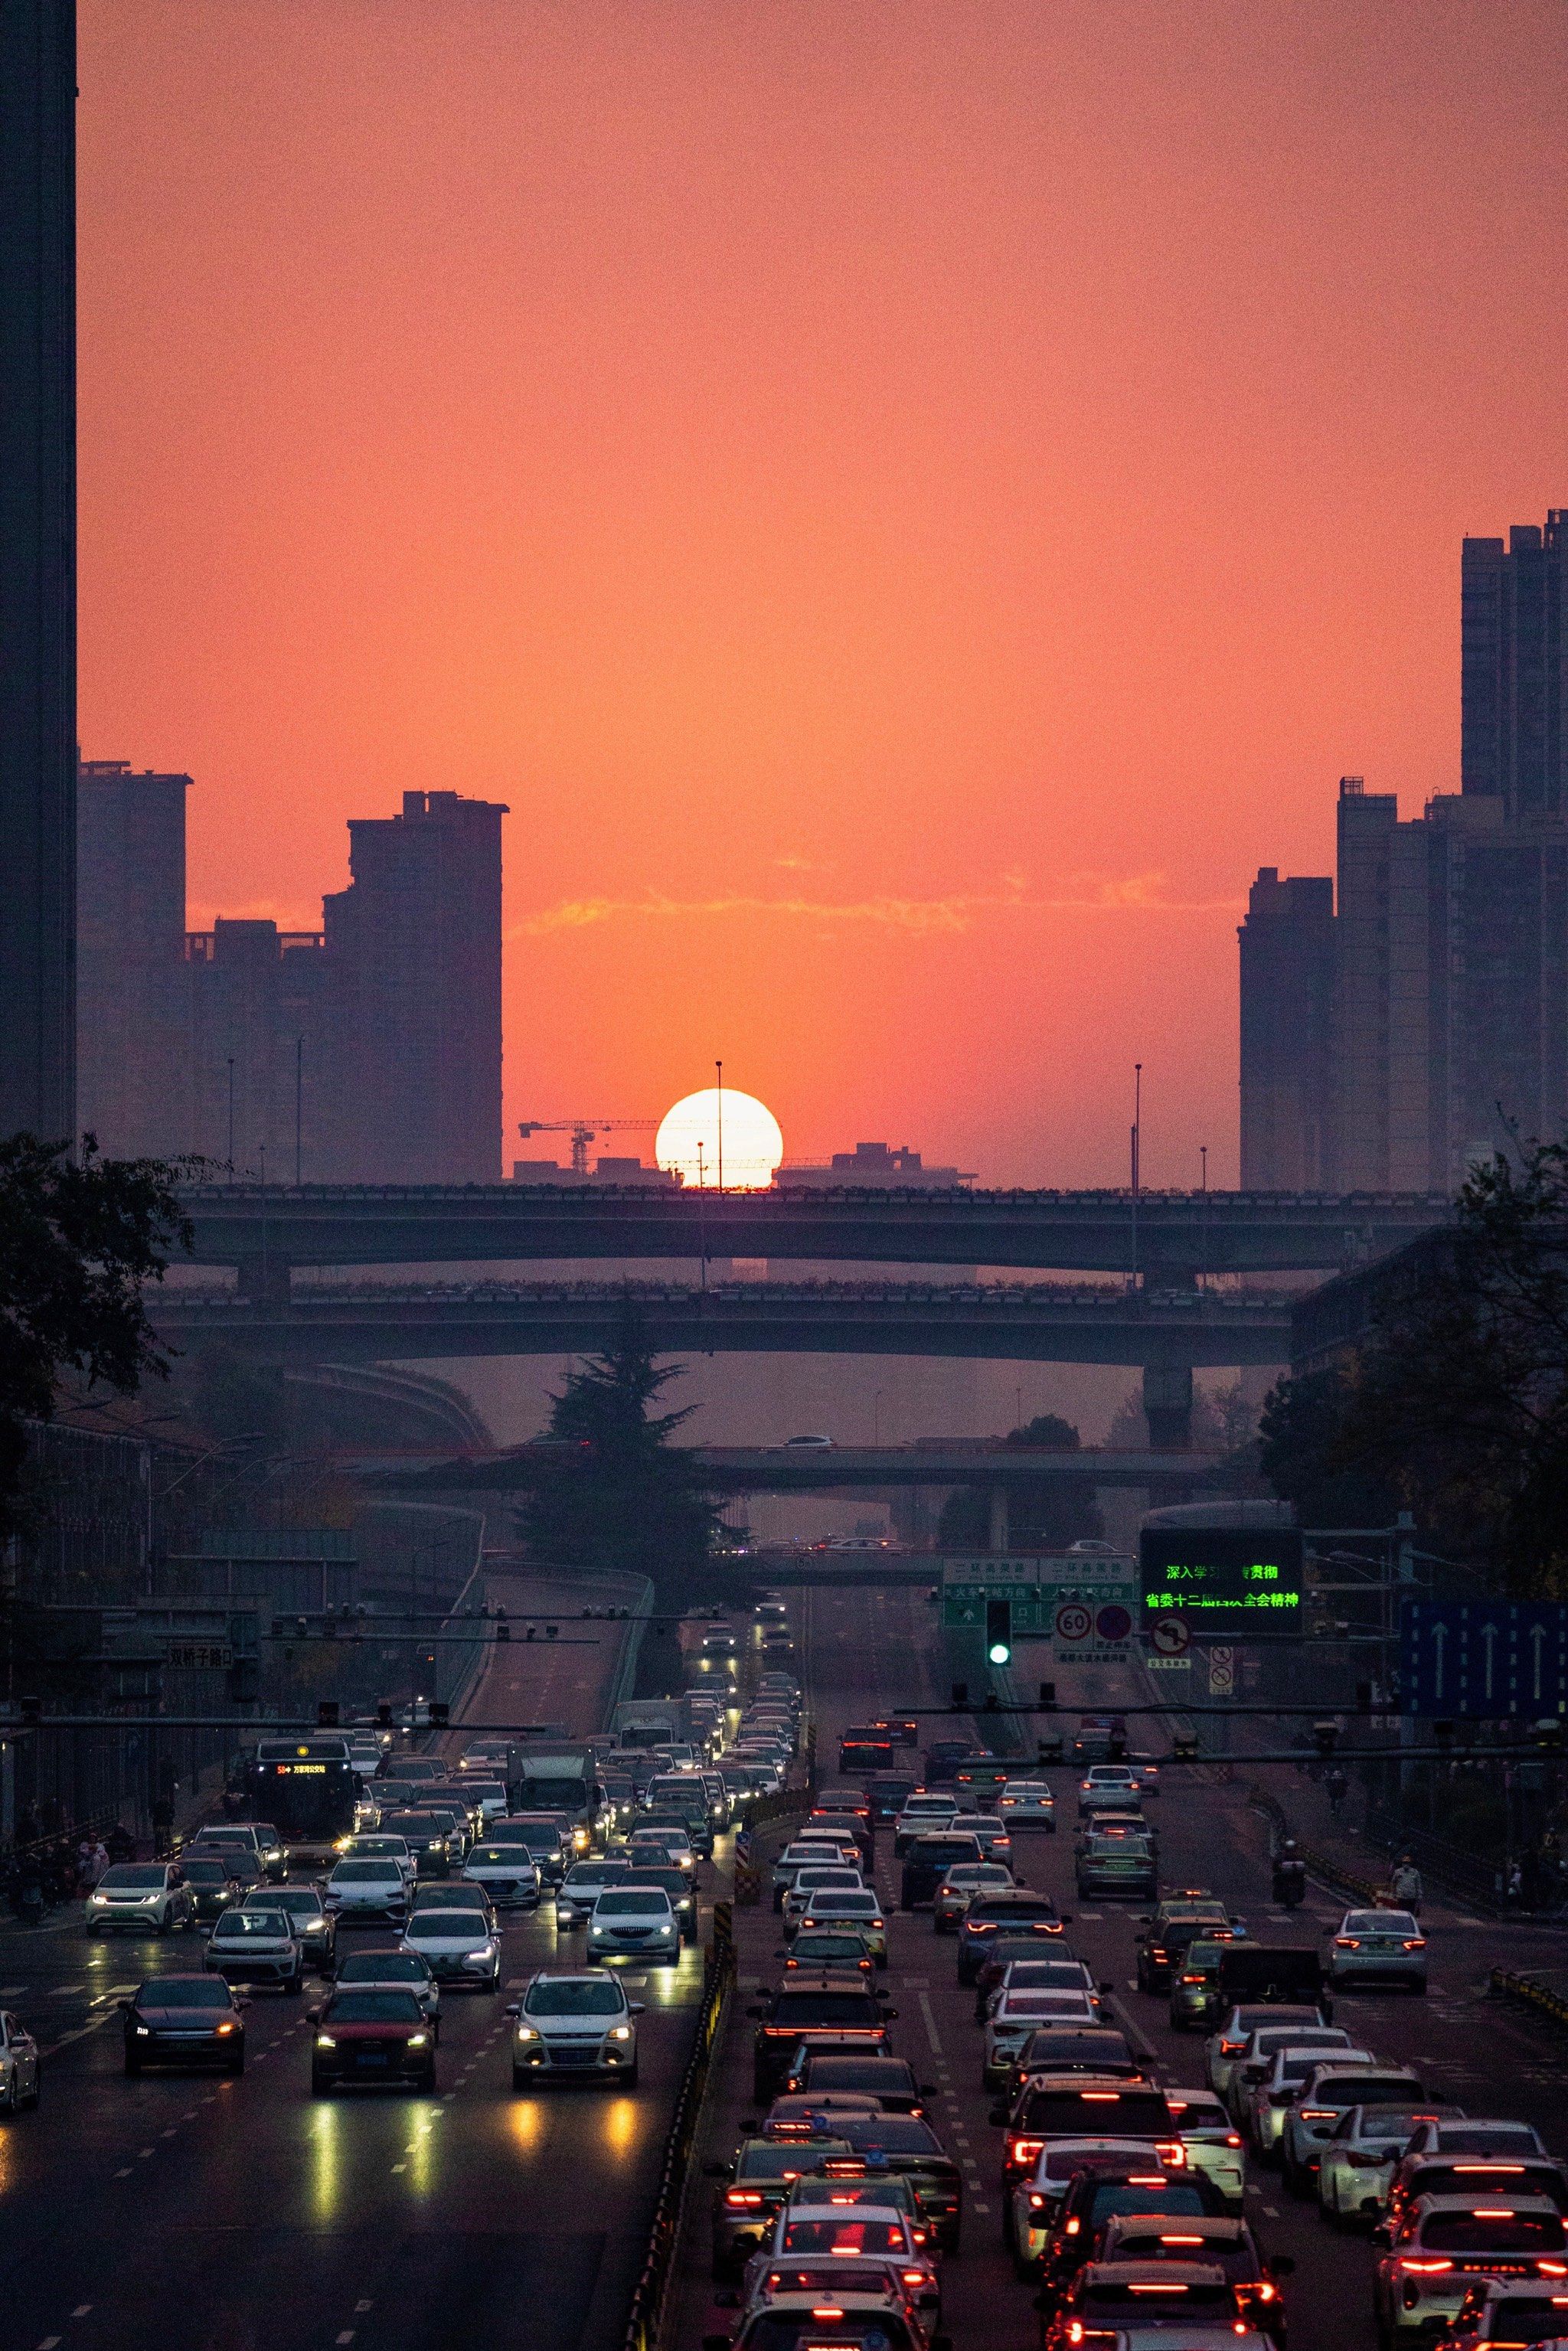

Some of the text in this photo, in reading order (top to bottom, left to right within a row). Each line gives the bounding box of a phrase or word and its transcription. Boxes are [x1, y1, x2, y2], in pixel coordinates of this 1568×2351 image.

[1166, 1566, 1278, 1579] 深入学习贯彻
[1063, 1615, 1084, 1630] 60
[171, 1648, 231, 1667] 双桥子路口
